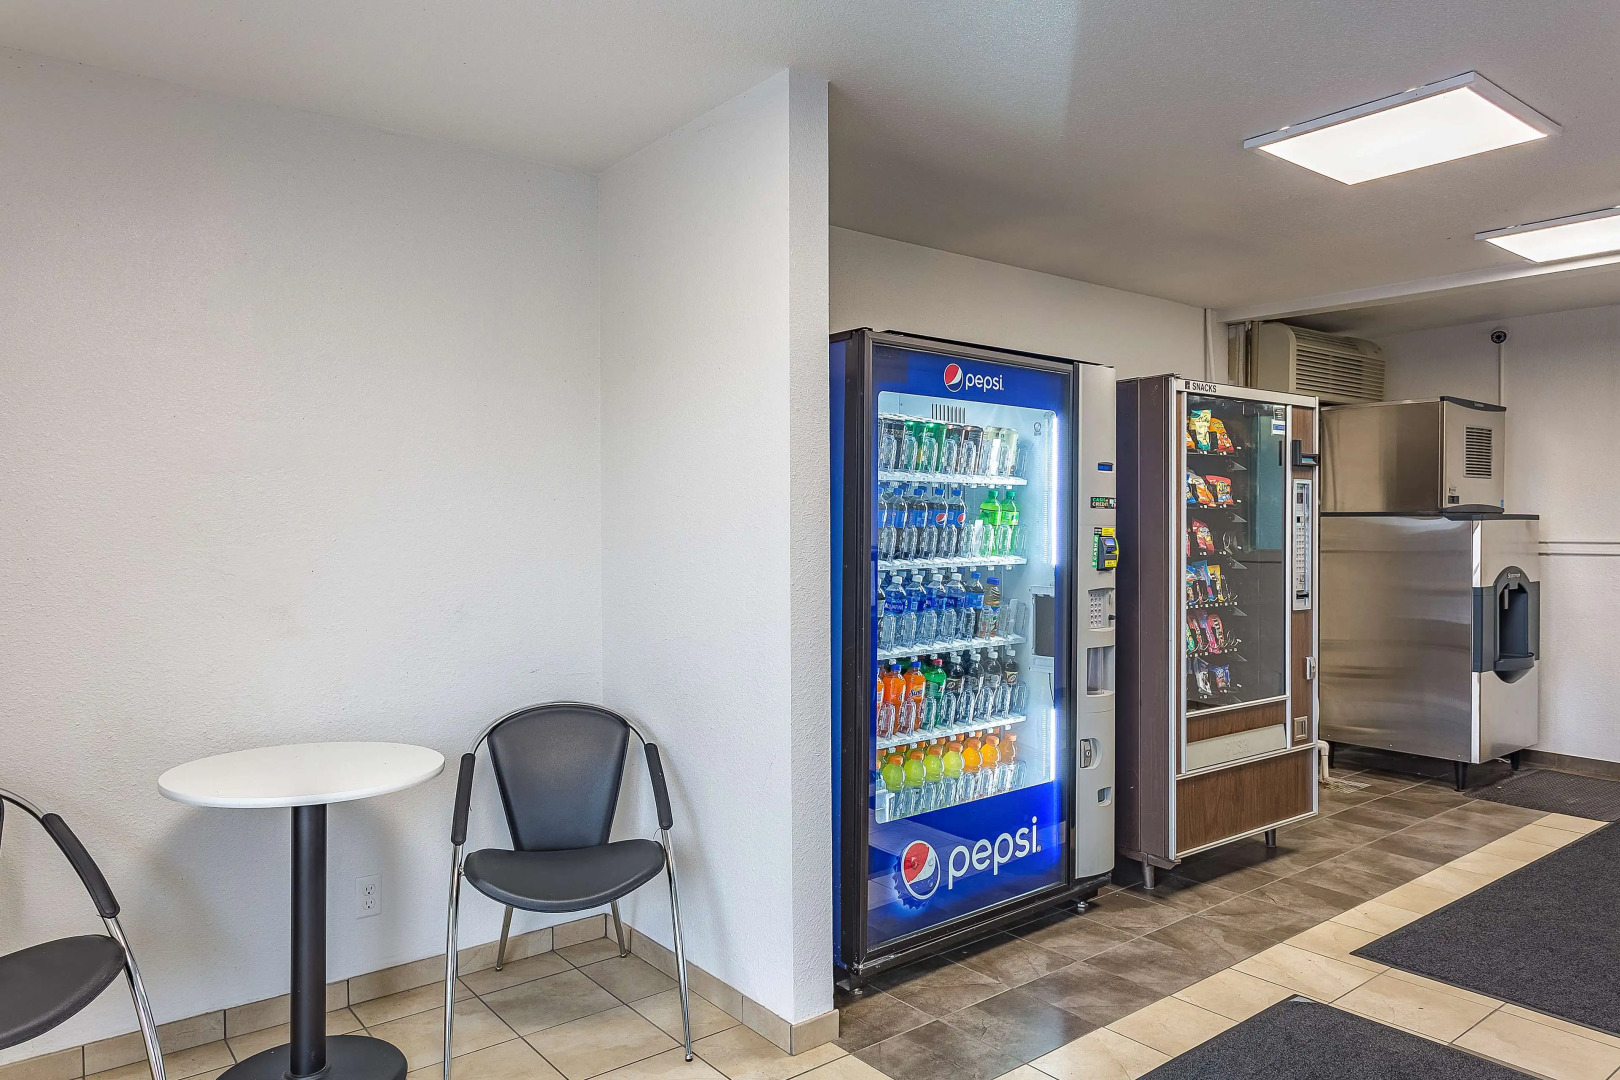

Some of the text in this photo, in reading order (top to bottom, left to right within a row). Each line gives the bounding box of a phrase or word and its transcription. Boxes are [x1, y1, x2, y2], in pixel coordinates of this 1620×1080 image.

[965, 373, 1003, 393] pepsi
[1192, 382, 1217, 393] SNACKS
[948, 816, 1038, 890] pepsi
